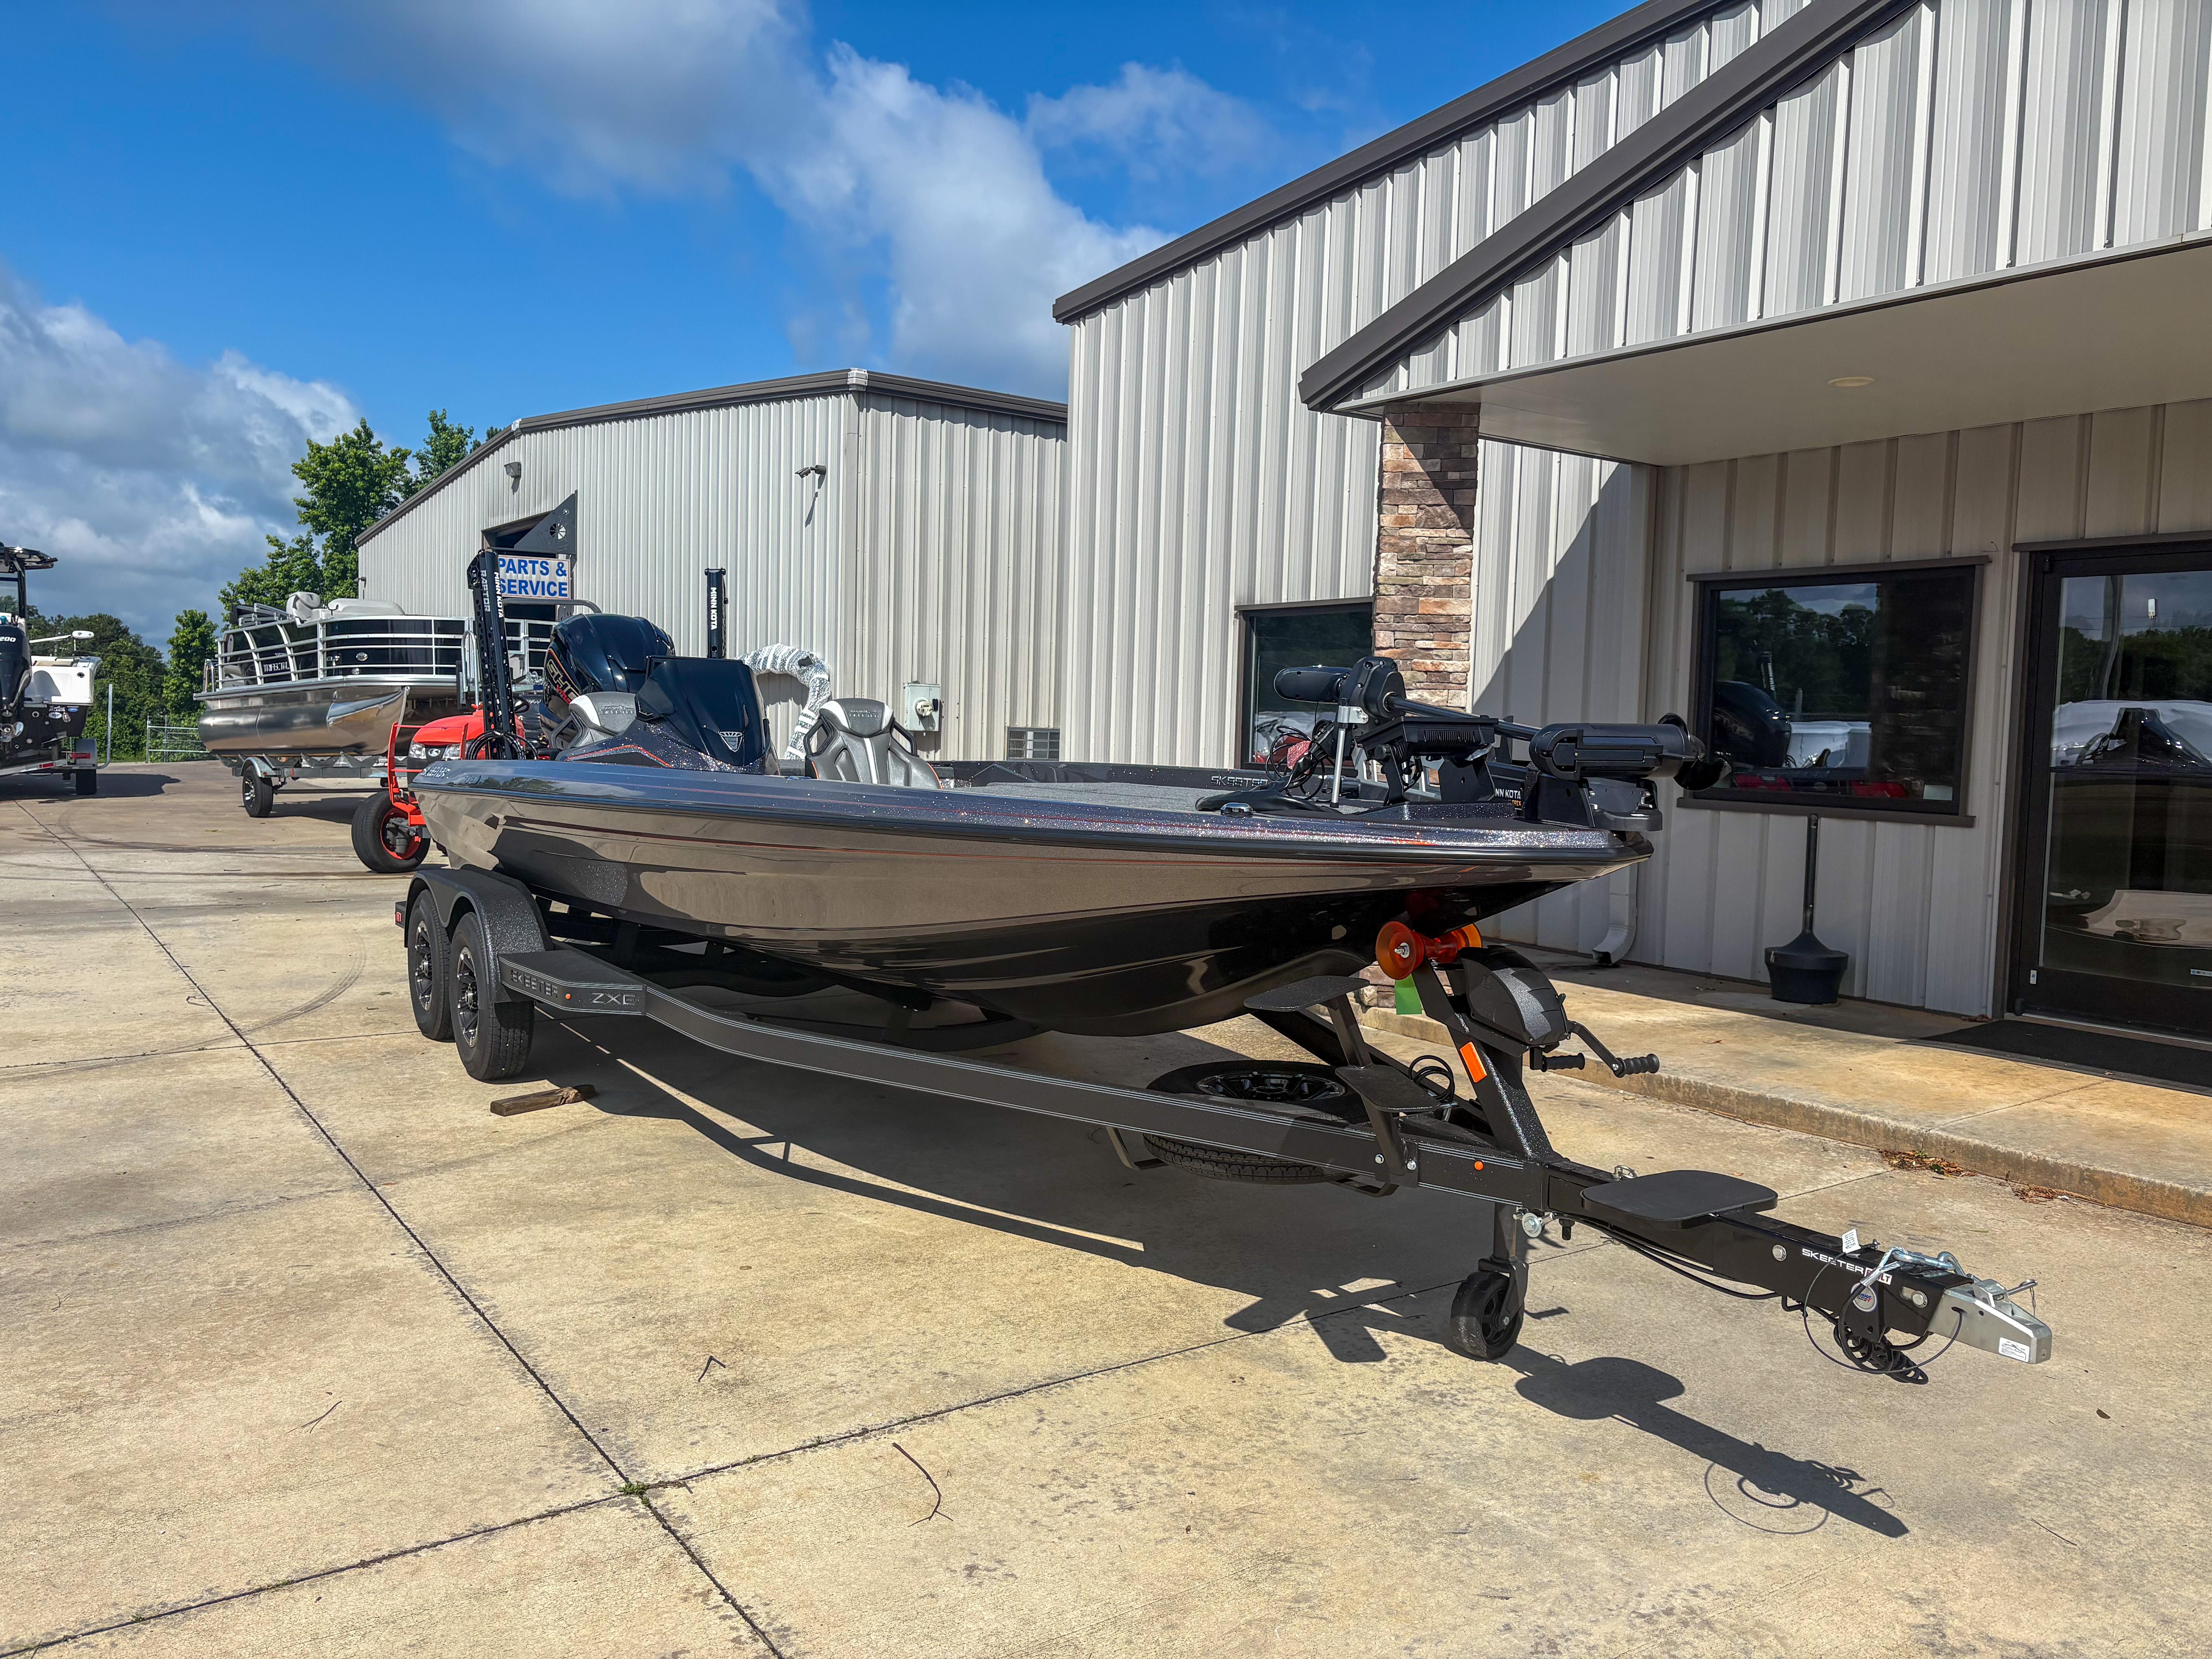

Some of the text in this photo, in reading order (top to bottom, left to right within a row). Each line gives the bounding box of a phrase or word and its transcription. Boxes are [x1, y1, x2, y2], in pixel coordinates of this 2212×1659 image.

[556, 562, 567, 577] &
[480, 570, 491, 613] RAPTOR
[1211, 776, 1268, 787] SKEETER
[1495, 788, 1521, 799] NN KOTA
[511, 969, 558, 999] SKEETER
[1802, 1248, 1863, 1275] SKEETER
